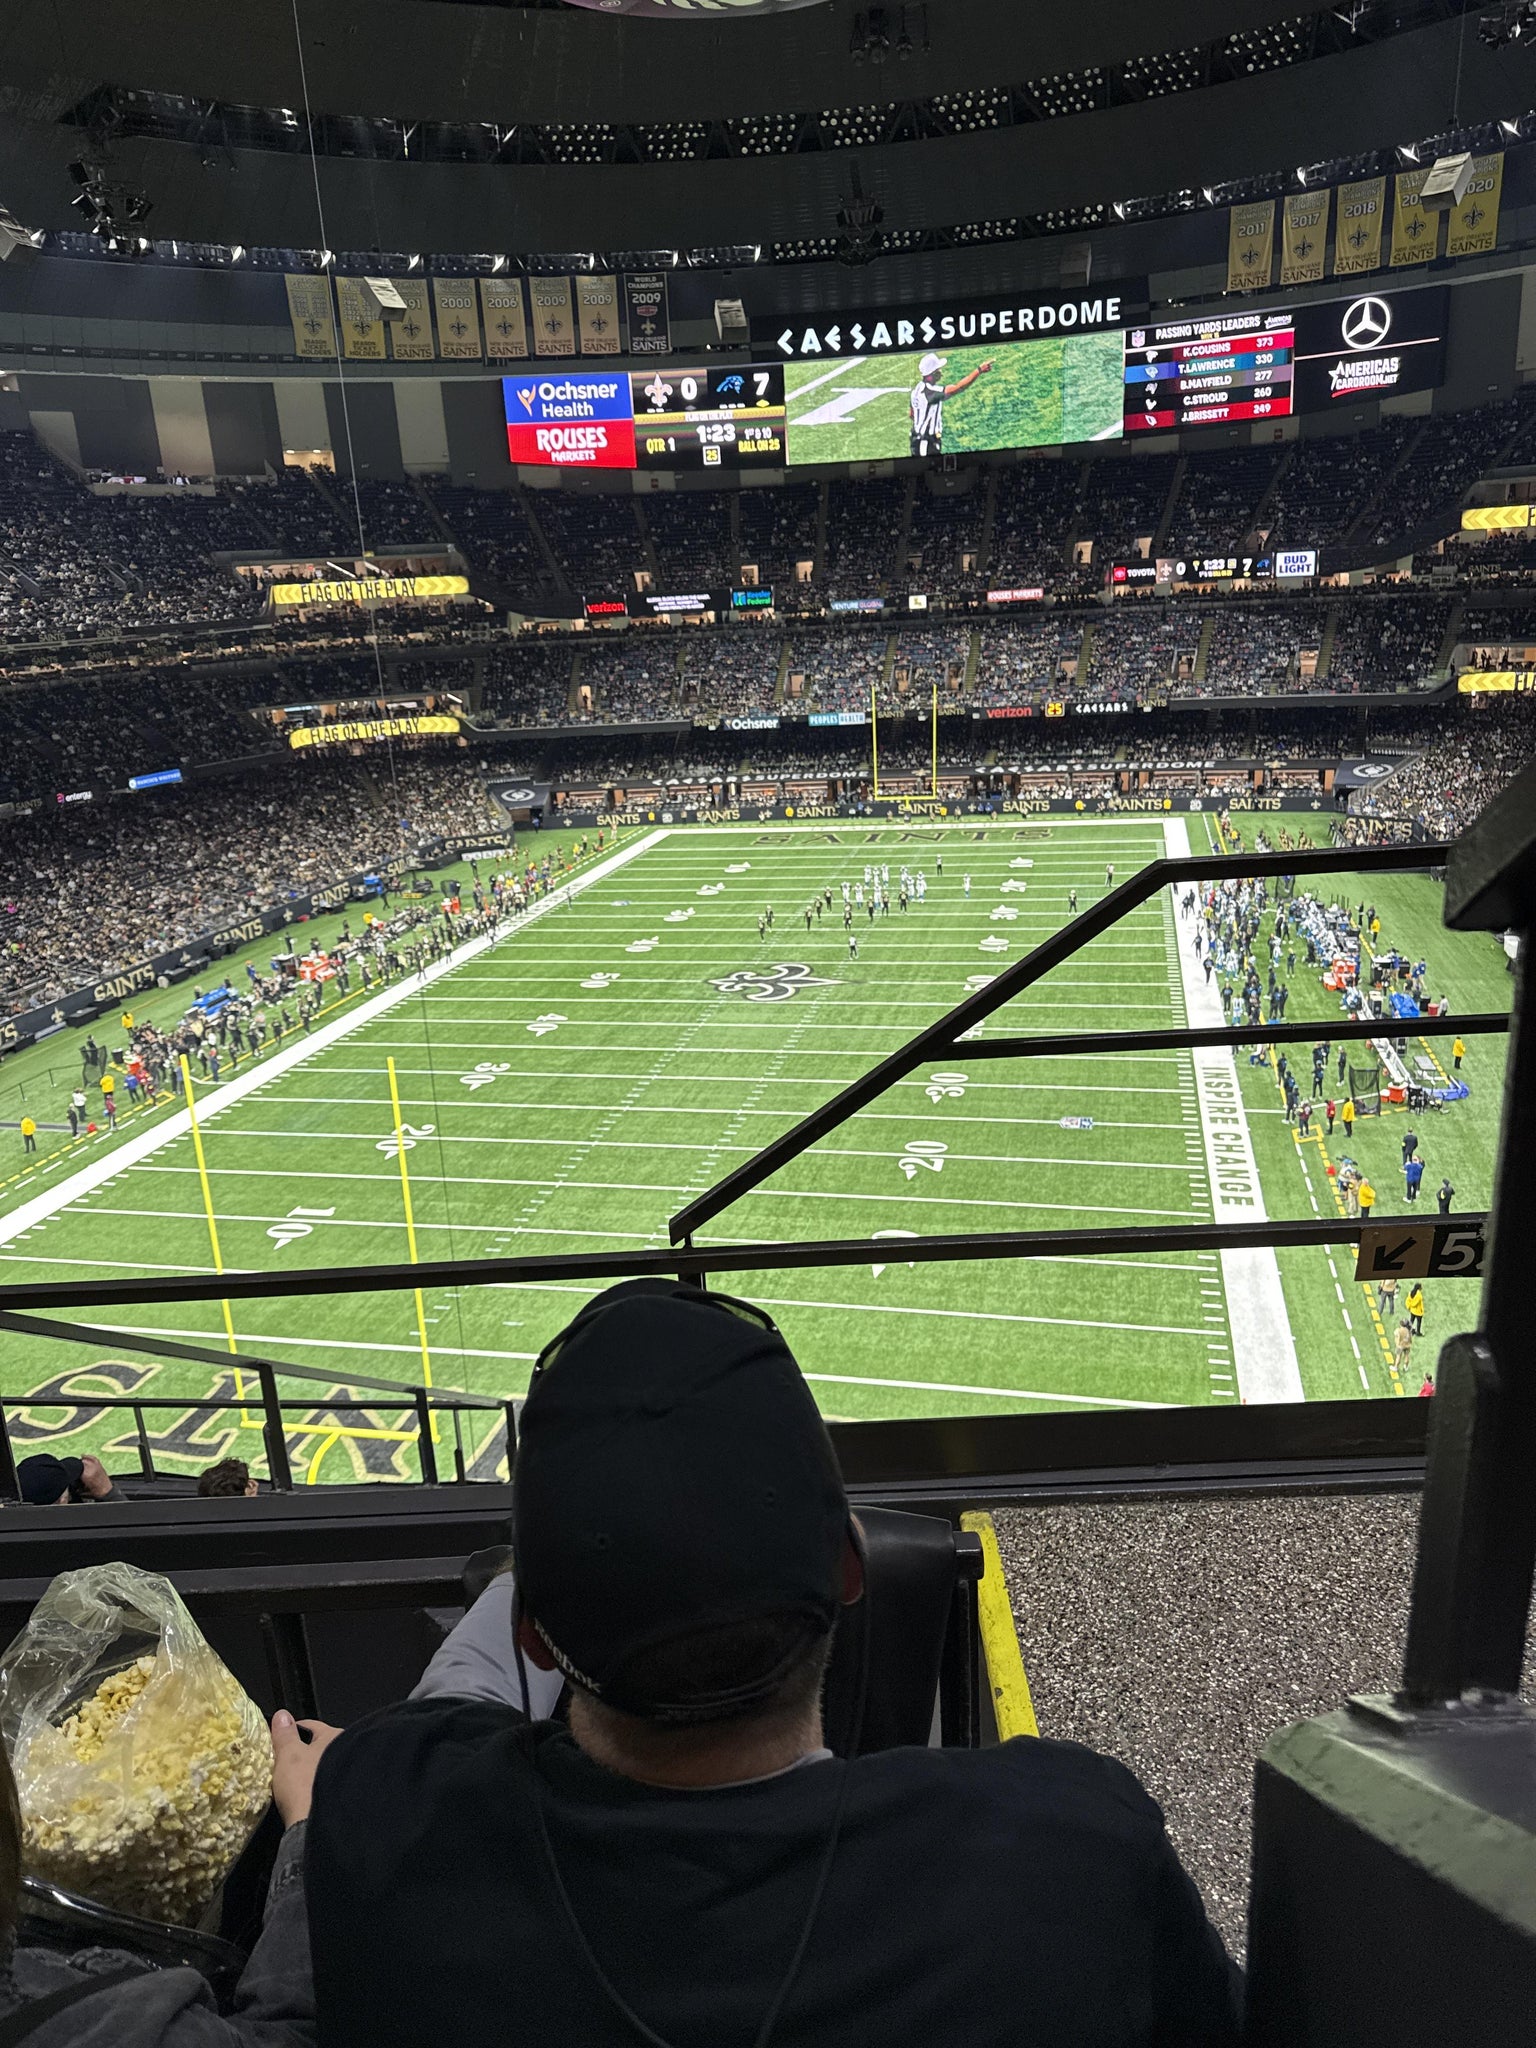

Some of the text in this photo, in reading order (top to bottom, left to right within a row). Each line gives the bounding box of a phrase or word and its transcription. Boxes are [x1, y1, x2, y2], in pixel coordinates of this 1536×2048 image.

[1464, 178, 1494, 194] 020
[1402, 193, 1420, 207] 20
[1345, 201, 1376, 217] 2018
[1291, 213, 1320, 228] 2017
[1238, 222, 1265, 237] 2011
[1450, 238, 1492, 254] SAINTS
[1393, 248, 1434, 264] SAINTS
[1336, 257, 1378, 272] SAINTS
[1230, 275, 1268, 290] SAINTS
[1283, 270, 1320, 282] SAINTS
[628, 281, 664, 289] CHAMPIONS
[407, 299, 421, 310] 91
[441, 298, 471, 309] 2000
[487, 297, 517, 308] 2006
[537, 295, 566, 306] 2009
[583, 294, 612, 305] 2009
[632, 292, 661, 304] 2009
[777, 316, 937, 355] CAESARS
[941, 297, 1121, 339] SUPERDOME
[1155, 325, 1192, 340] PASSING
[1192, 321, 1222, 336] YARDS
[1222, 315, 1261, 331] LEADERS
[444, 347, 478, 357] SAINTS
[490, 346, 524, 356] SAINTS
[538, 344, 572, 353] SAINTS
[584, 343, 618, 352] SAINTS
[632, 341, 667, 351] SAINTS
[1183, 337, 1273, 357] K.COUSINS 373
[396, 349, 432, 358] SAINTS
[1178, 354, 1273, 374] T.LAWRENCE 330
[1336, 357, 1399, 378] AMERICAS
[681, 372, 770, 400] 0 7
[1180, 370, 1273, 390] B.MAYFIELD 277
[538, 381, 618, 401] Ochsner
[1183, 387, 1272, 406] C.STROUD 260
[542, 401, 594, 417] Health
[1181, 404, 1271, 423] J.BRISSETT 249
[536, 426, 608, 453] ROUSES
[696, 423, 736, 443] 1:23
[762, 426, 772, 439] 10
[646, 437, 676, 454] QTR 1
[738, 438, 780, 453] BALL ON 25
[551, 450, 596, 462] MARKETS
[706, 450, 718, 461] 25
[1284, 555, 1307, 564] BUD
[1127, 567, 1156, 578] TOYOTA
[1176, 562, 1186, 576] 0
[1203, 559, 1225, 571] 1:23
[1243, 558, 1253, 571] 7
[1279, 563, 1312, 574] LIGHT
[301, 579, 416, 602] FLAG ON THE PLAY
[988, 588, 1044, 601] ROUSES MARKETS
[587, 601, 625, 613] verizon
[831, 600, 859, 611] VENTURE
[859, 599, 884, 609] GLOBAL
[877, 710, 905, 718] SAINTS
[937, 707, 965, 716] SAINTS
[986, 706, 1032, 718] verizon
[1047, 703, 1063, 715] 25
[1075, 701, 1128, 714] CAESARS
[732, 718, 779, 730] Ochsner
[810, 713, 838, 725] PEOPLES
[311, 718, 419, 744] FLAG ON THE PLAY
[1086, 760, 1217, 771] SUPERDOME
[755, 770, 870, 782] SUPERDOME
[65, 791, 93, 802] entergy
[1003, 801, 1050, 813] SAINTS
[1229, 799, 1281, 811] SAINTS
[596, 813, 641, 826] SAINTS
[696, 808, 741, 822] SAINTS
[750, 829, 1053, 846] SAINTS
[94, 964, 155, 1001] SAINTS
[526, 1013, 568, 1031] 40
[460, 1062, 511, 1084] 30
[925, 1072, 969, 1098] 30
[376, 1123, 435, 1152] 20
[1202, 1067, 1254, 1206] INSPIRE CHANGE
[898, 1140, 948, 1172] 20
[266, 1206, 336, 1239] 10
[1437, 1231, 1484, 1272] 5
